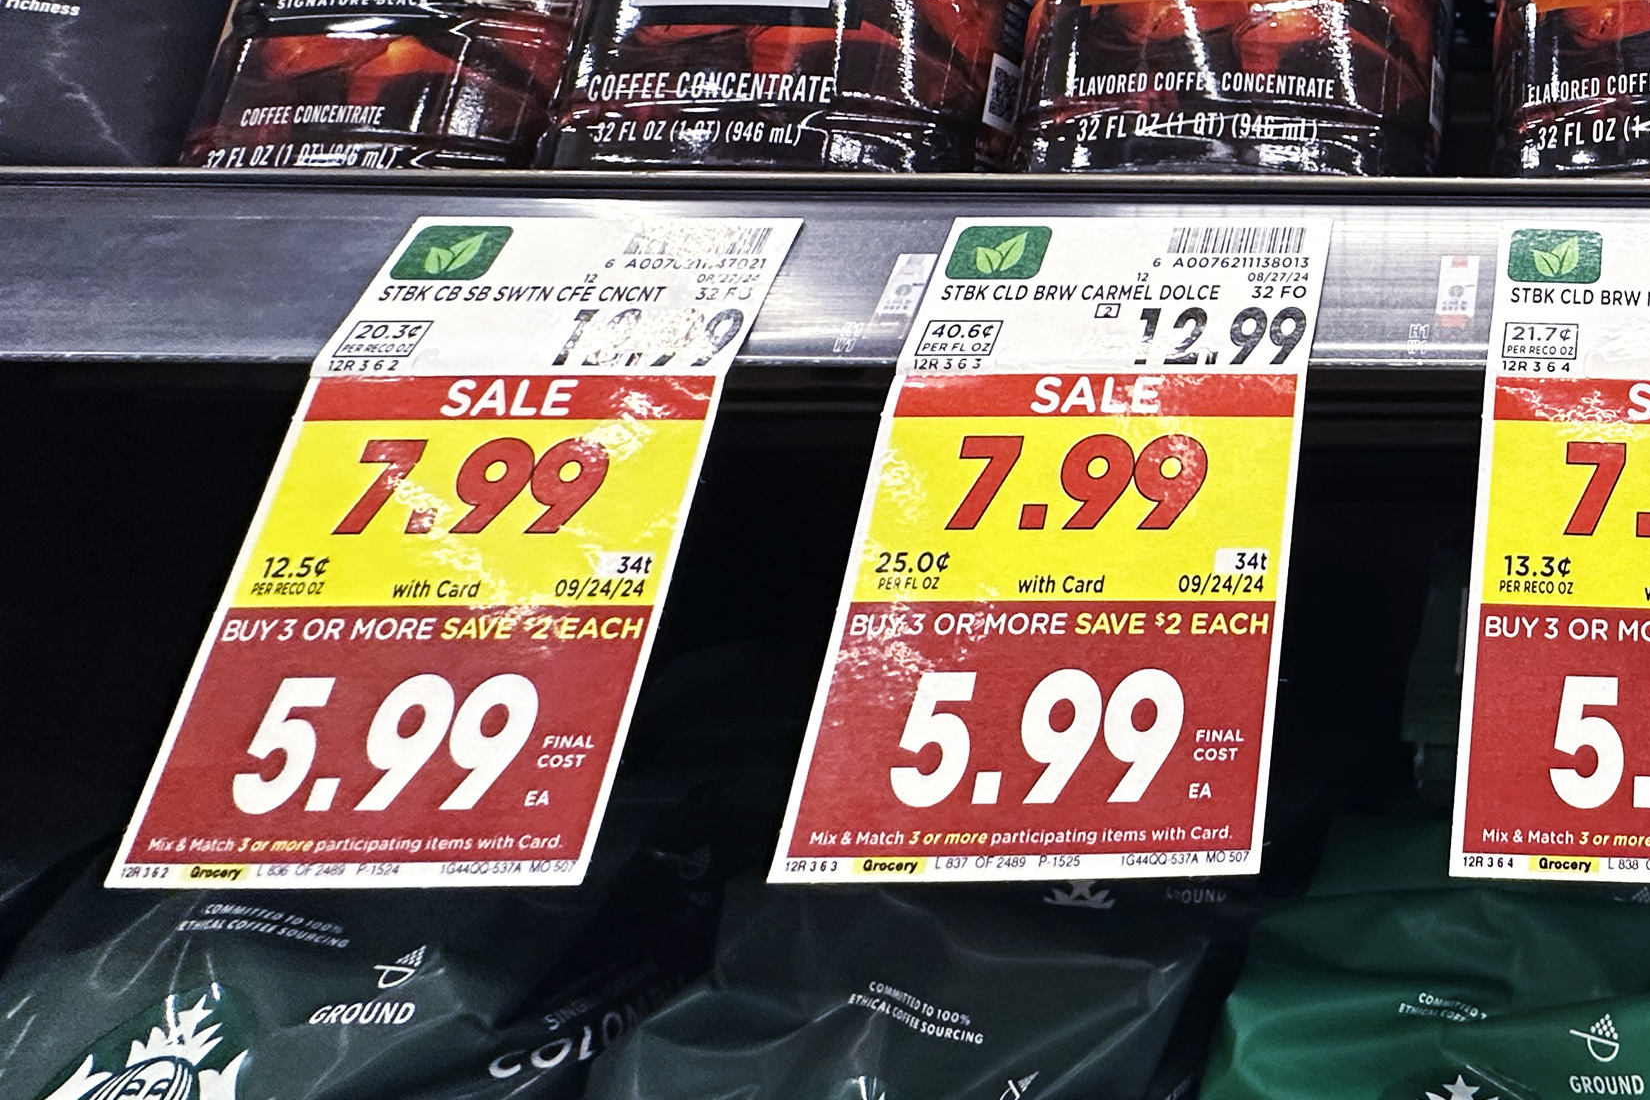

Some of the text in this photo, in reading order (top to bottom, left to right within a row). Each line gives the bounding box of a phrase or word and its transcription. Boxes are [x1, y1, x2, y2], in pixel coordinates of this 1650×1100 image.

[586, 72, 836, 103] COFFEE CONCENTRATE
[240, 105, 385, 128] COFFEE CONCENTRATE
[940, 284, 1221, 300] STBK CLD BRW CARMEL DOLCE
[931, 323, 993, 340] 40.6¢
[1134, 305, 1308, 366] 12.99
[440, 379, 579, 417] SALE
[1030, 376, 1165, 414] SALE
[331, 437, 609, 535] 7.99
[944, 434, 1209, 531] 7.99
[261, 556, 331, 579] 12.5¢
[231, 672, 539, 815] 5.99
[890, 668, 1185, 808] 5.99
[862, 859, 918, 874] Grocery
[308, 1000, 416, 1026] GROUND
[1569, 1074, 1644, 1097] GROUND
